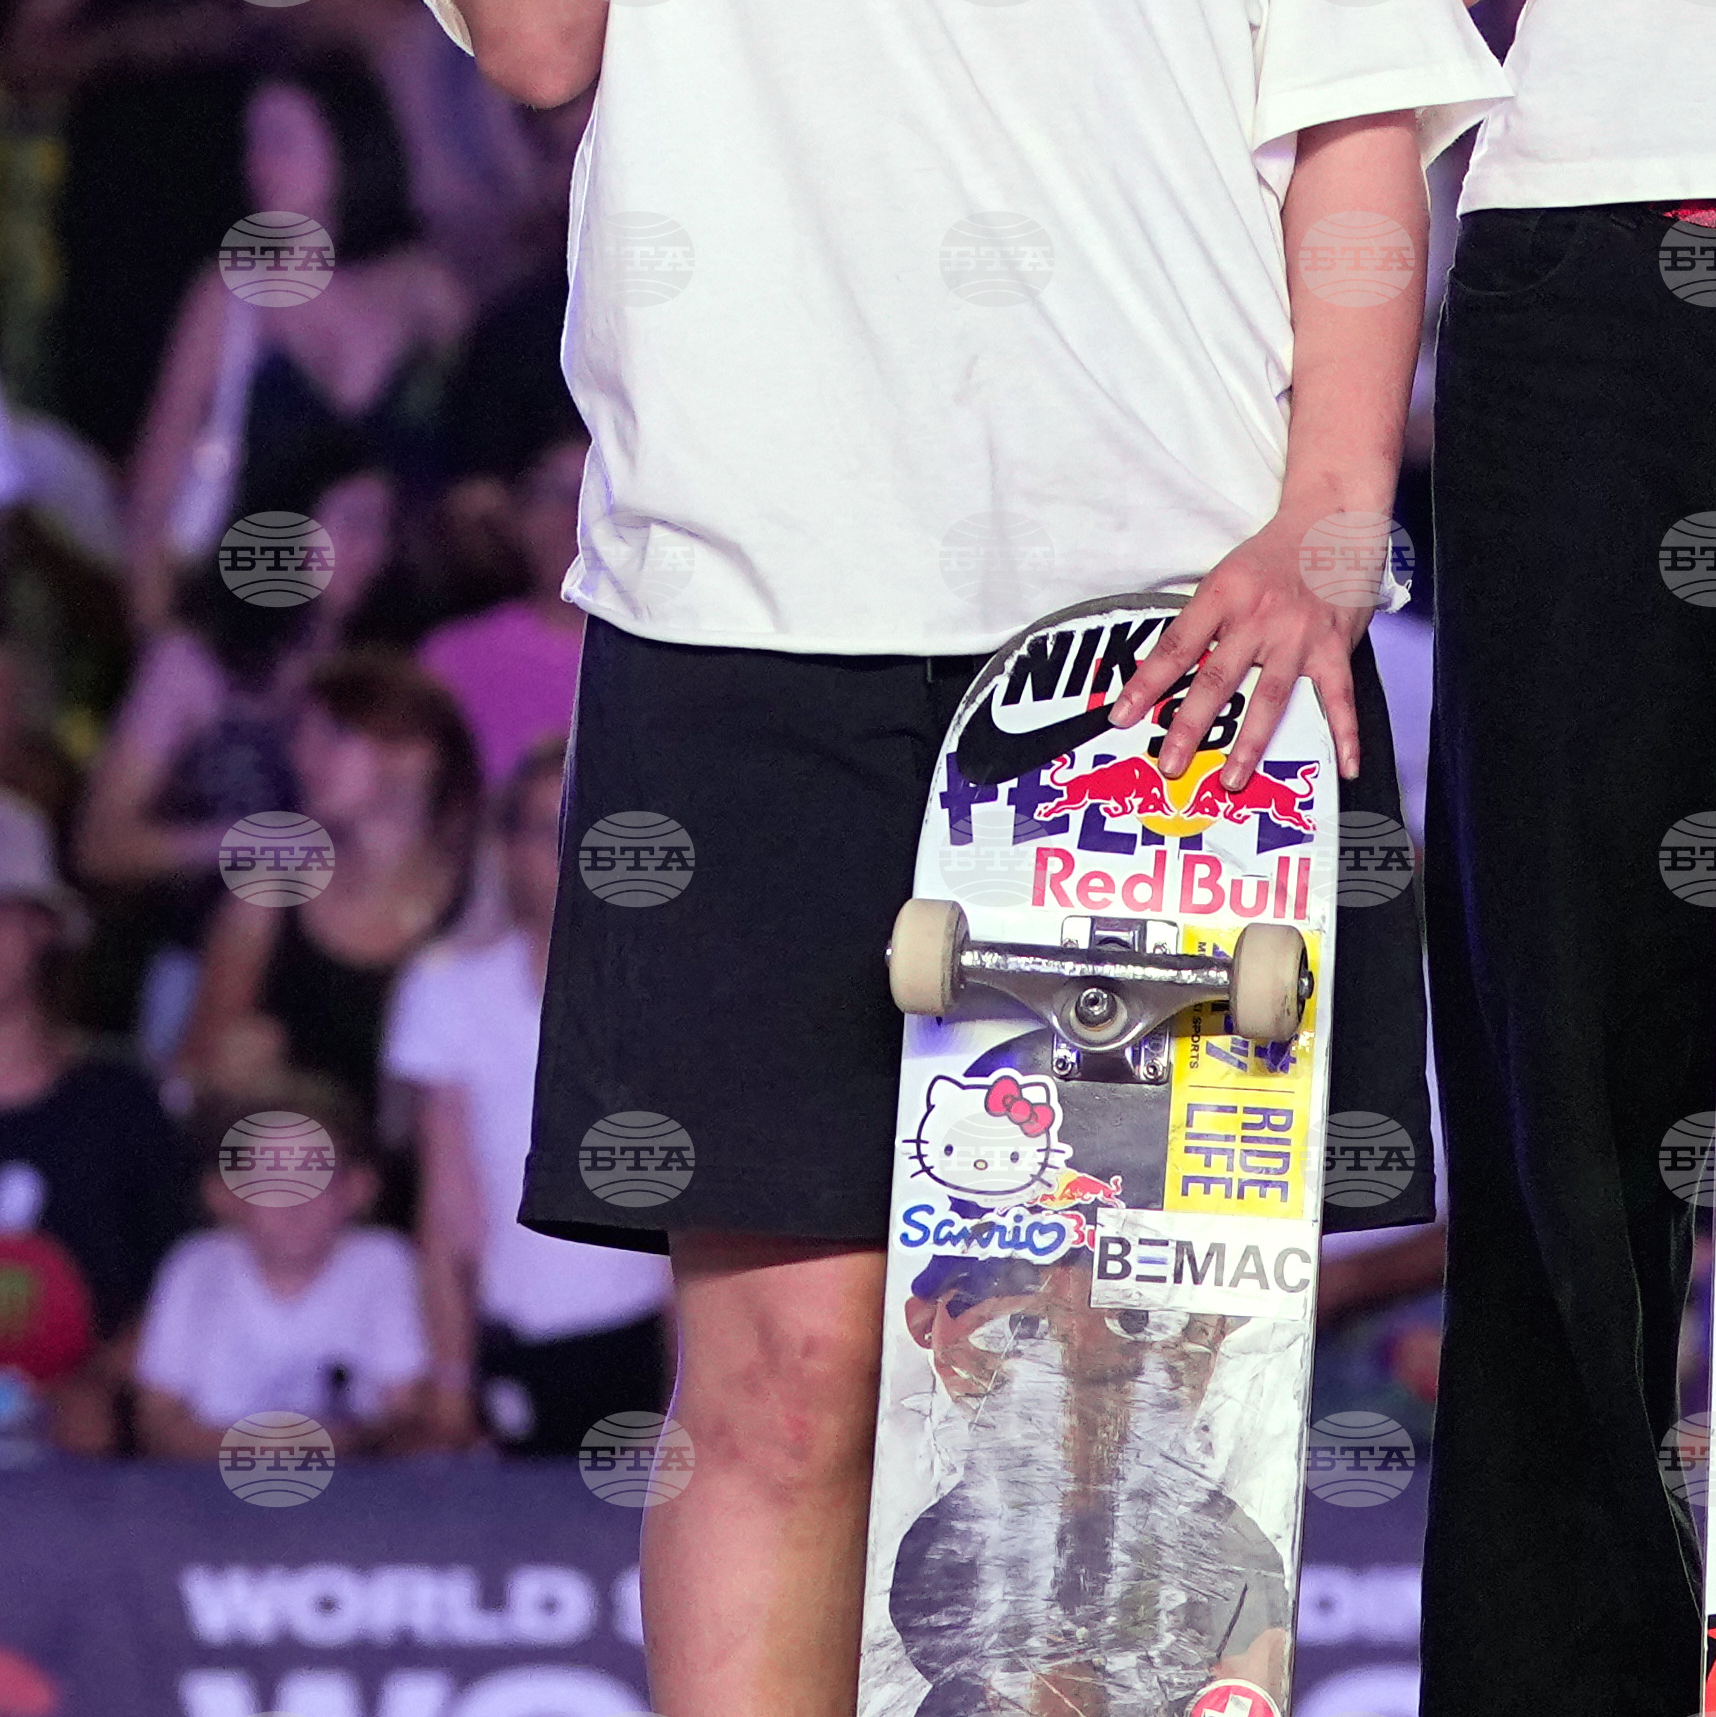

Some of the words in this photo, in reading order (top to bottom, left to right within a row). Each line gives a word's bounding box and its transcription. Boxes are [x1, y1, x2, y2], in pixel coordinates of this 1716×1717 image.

[1001, 616, 1183, 707] NIK
[1031, 847, 1167, 913] Red
[1179, 853, 1311, 921] Bull
[1181, 1102, 1238, 1201] LIFE
[1236, 1106, 1294, 1202] RIDE
[1098, 1235, 1312, 1294] BEMAC
[181, 1561, 599, 1648] WORLD
